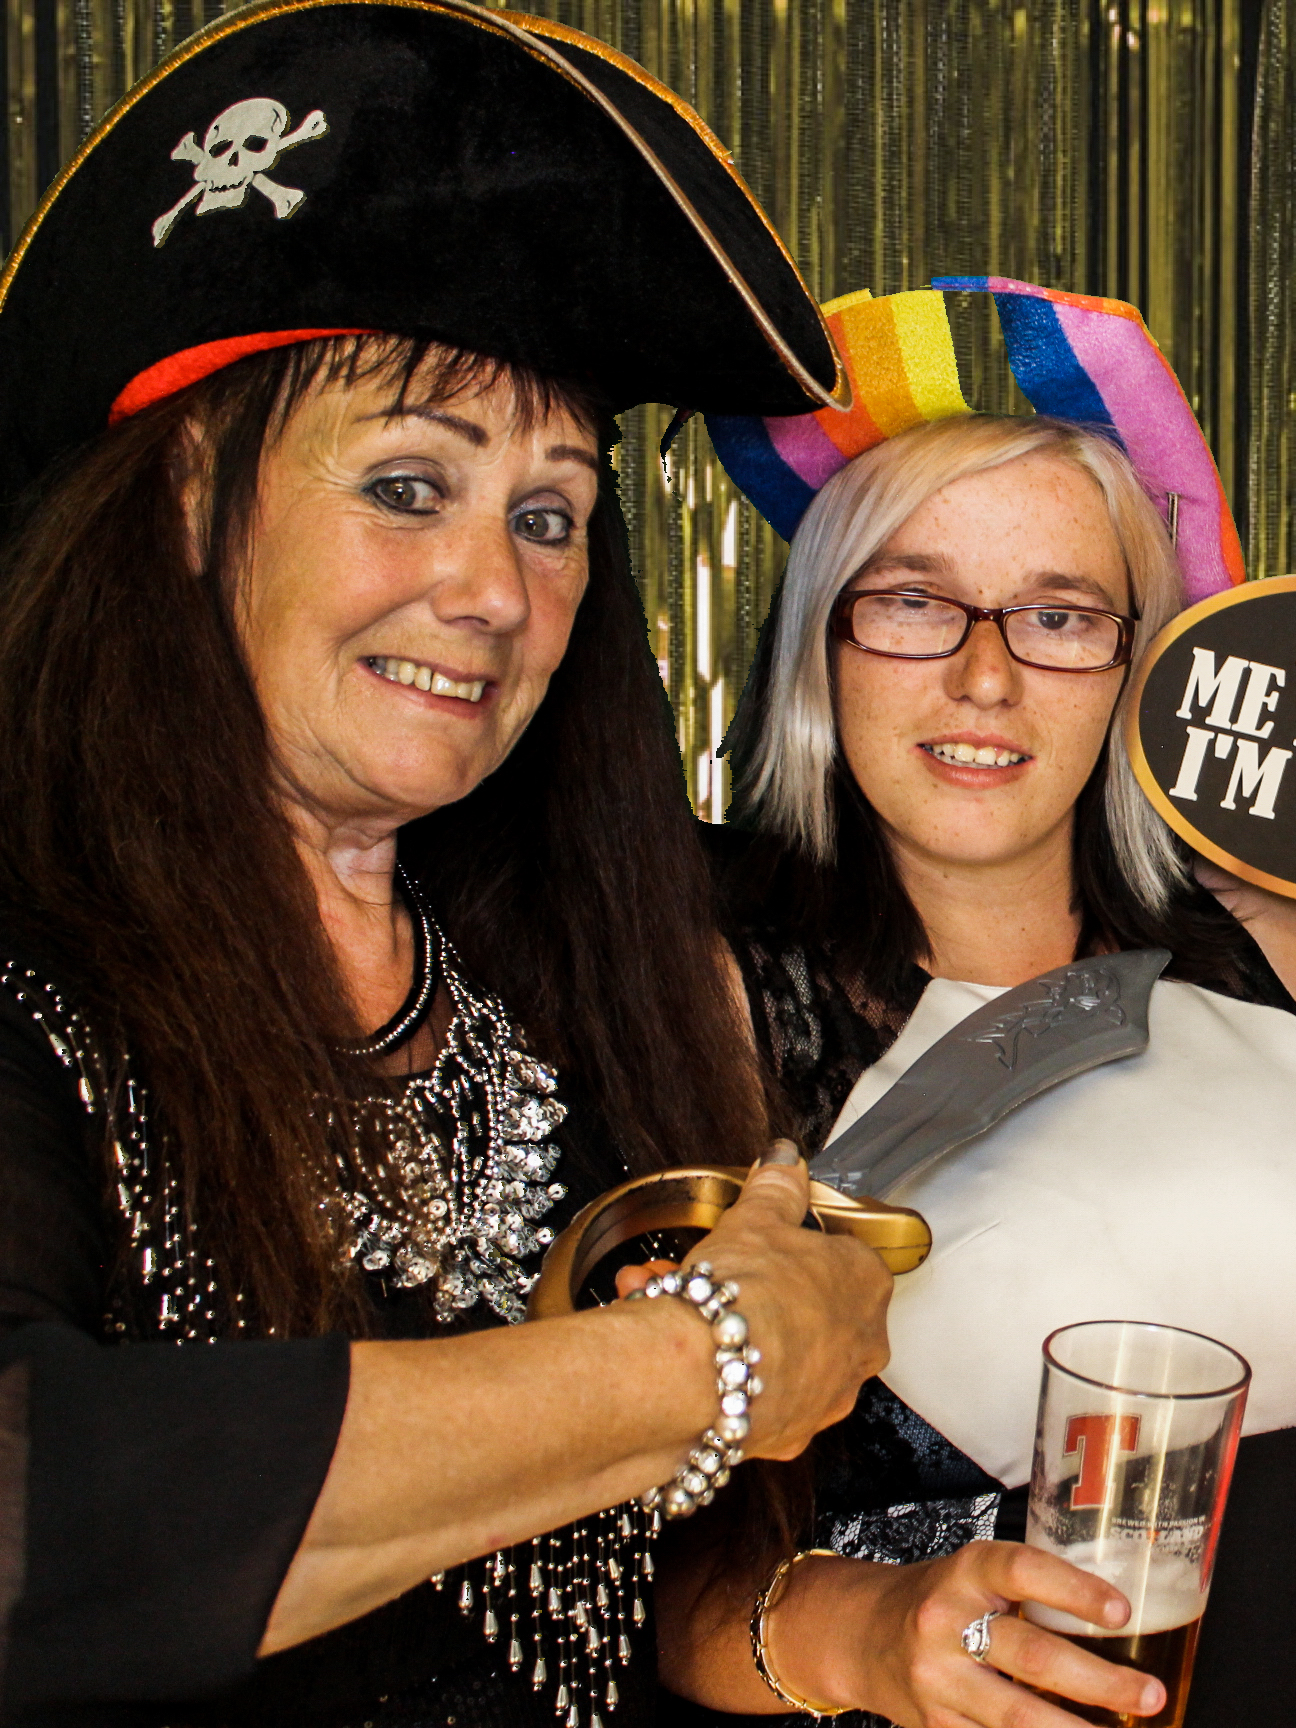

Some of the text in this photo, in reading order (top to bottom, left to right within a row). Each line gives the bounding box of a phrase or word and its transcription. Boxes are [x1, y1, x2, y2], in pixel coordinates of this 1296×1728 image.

[1175, 646, 1286, 739] ME
[1168, 725, 1293, 820] I'M
[1062, 1412, 1142, 1511] T
[1111, 1516, 1146, 1527] BREWED
[1169, 1516, 1199, 1528] PASSION
